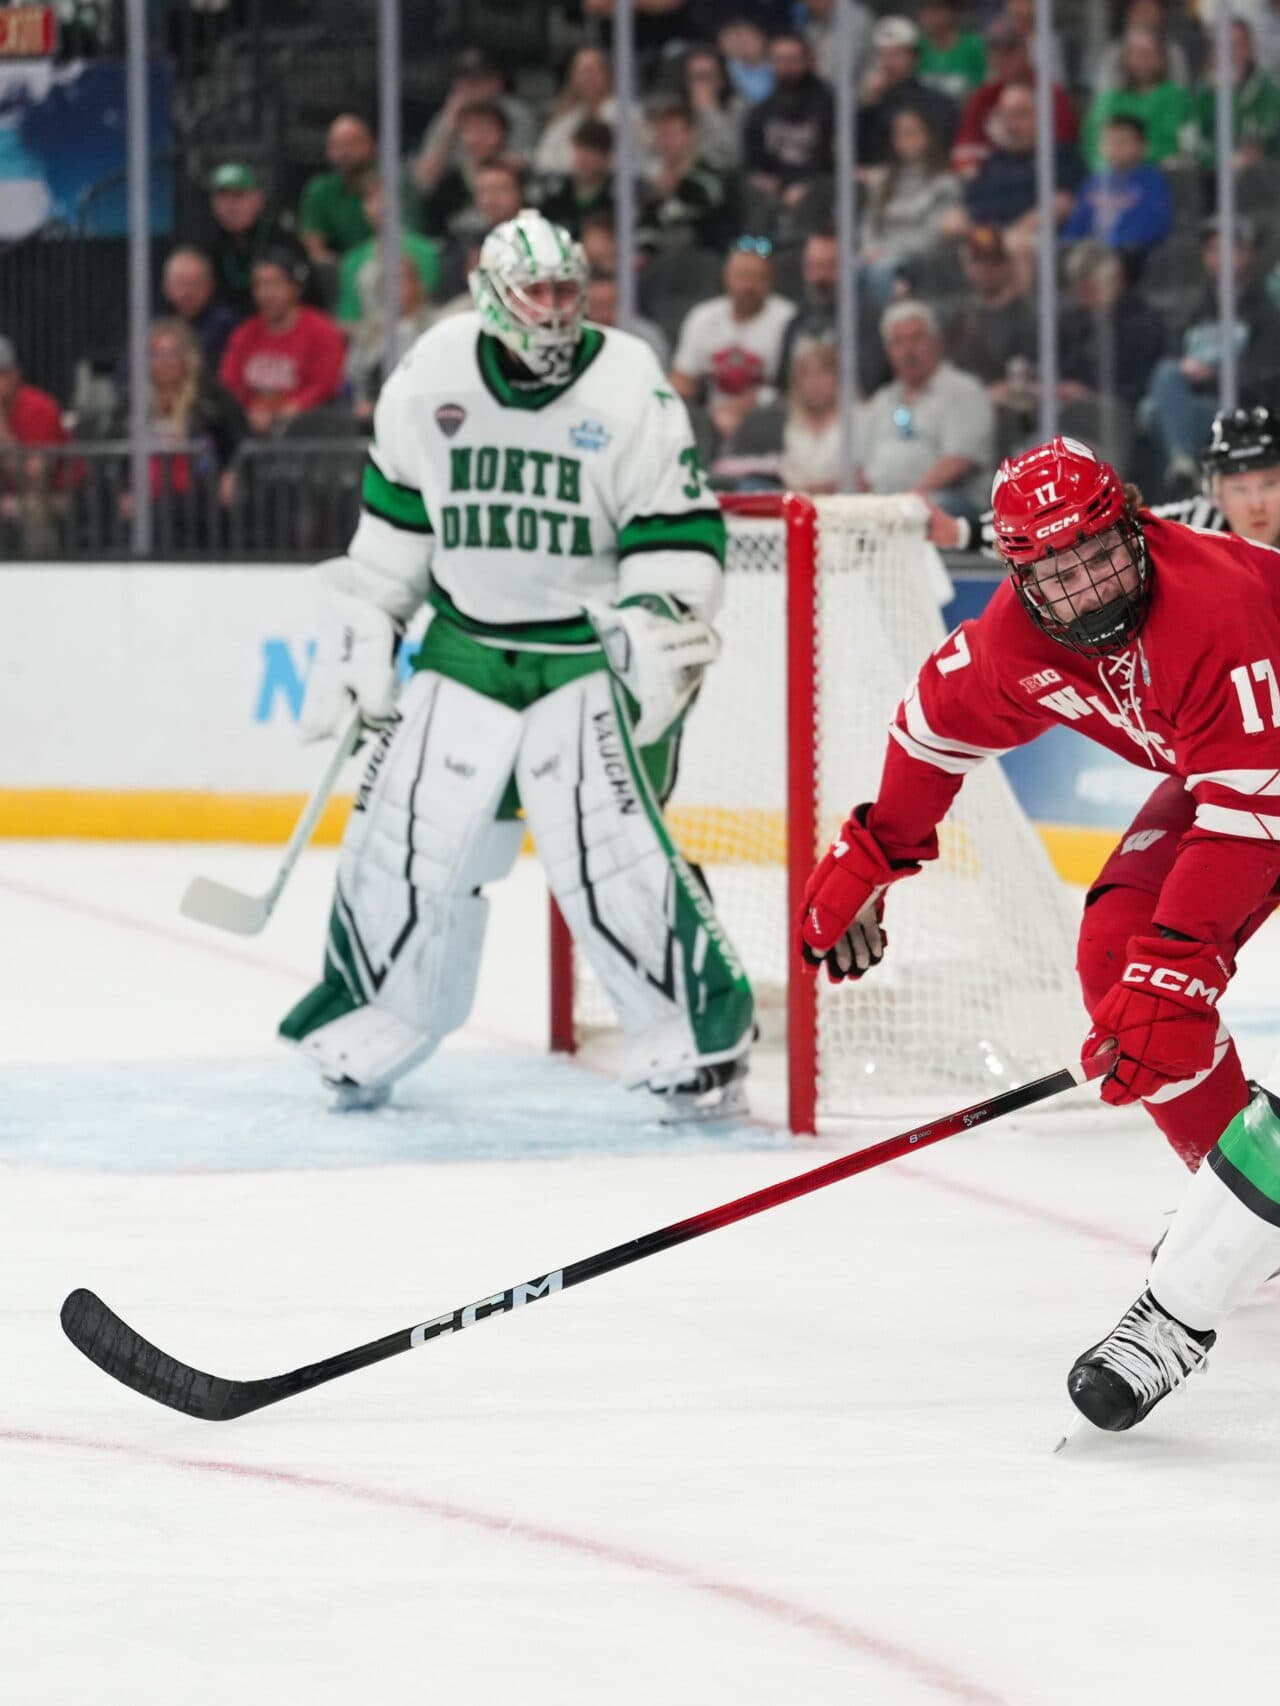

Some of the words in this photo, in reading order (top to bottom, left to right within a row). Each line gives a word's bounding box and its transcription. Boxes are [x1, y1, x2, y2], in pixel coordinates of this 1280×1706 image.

[450, 446, 581, 504] NORTH
[679, 447, 712, 498] 3
[1034, 481, 1058, 506] 17
[441, 503, 594, 557] DAKOTA
[1036, 513, 1080, 539] CCM
[593, 709, 639, 816] VAUGHN
[1122, 962, 1219, 1006] CCM
[410, 1269, 563, 1348] CCM
